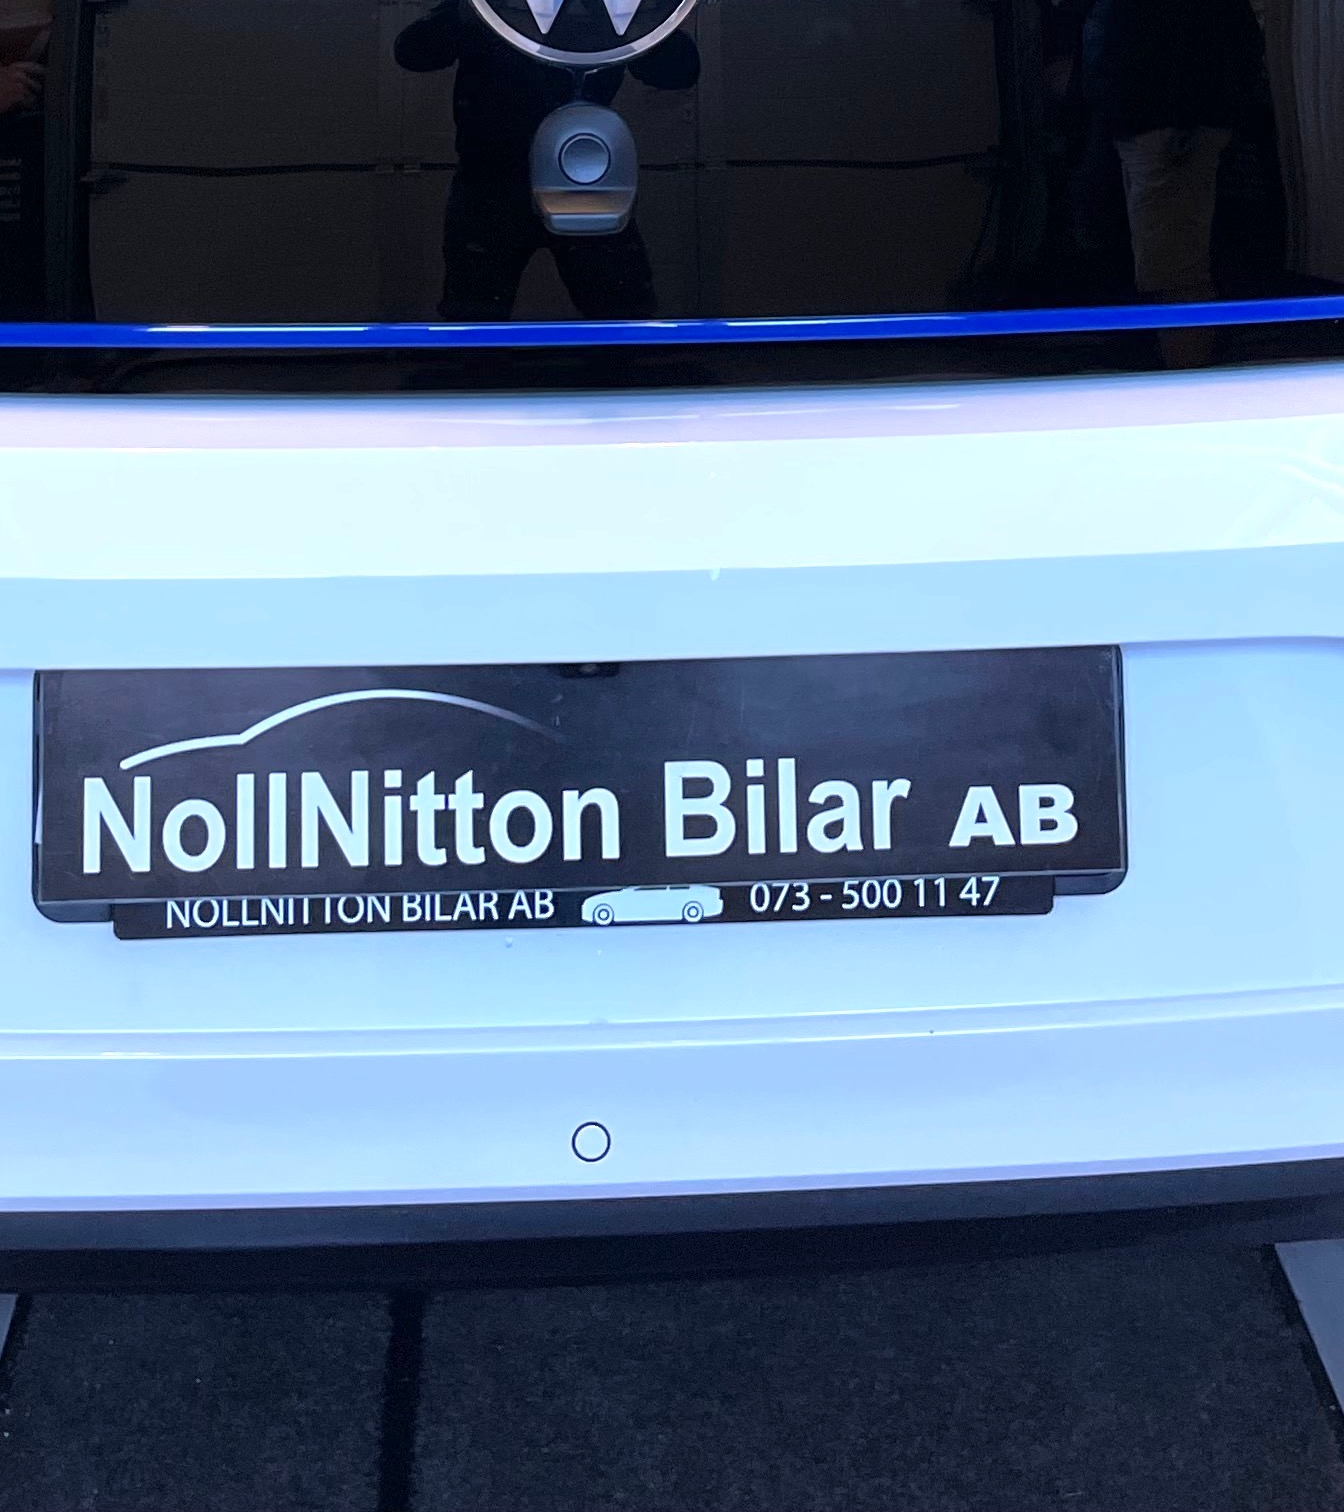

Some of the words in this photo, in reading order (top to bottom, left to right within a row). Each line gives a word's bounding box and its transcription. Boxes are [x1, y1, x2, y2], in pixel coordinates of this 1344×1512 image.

[83, 769, 620, 874] NollNitton
[664, 757, 911, 857] Bilar
[948, 783, 1080, 847] AB
[402, 891, 500, 924] BILAR
[508, 889, 555, 920] AB
[749, 882, 810, 912] 073
[841, 879, 902, 910] 500
[914, 877, 947, 908] 11
[958, 876, 1000, 906] 47
